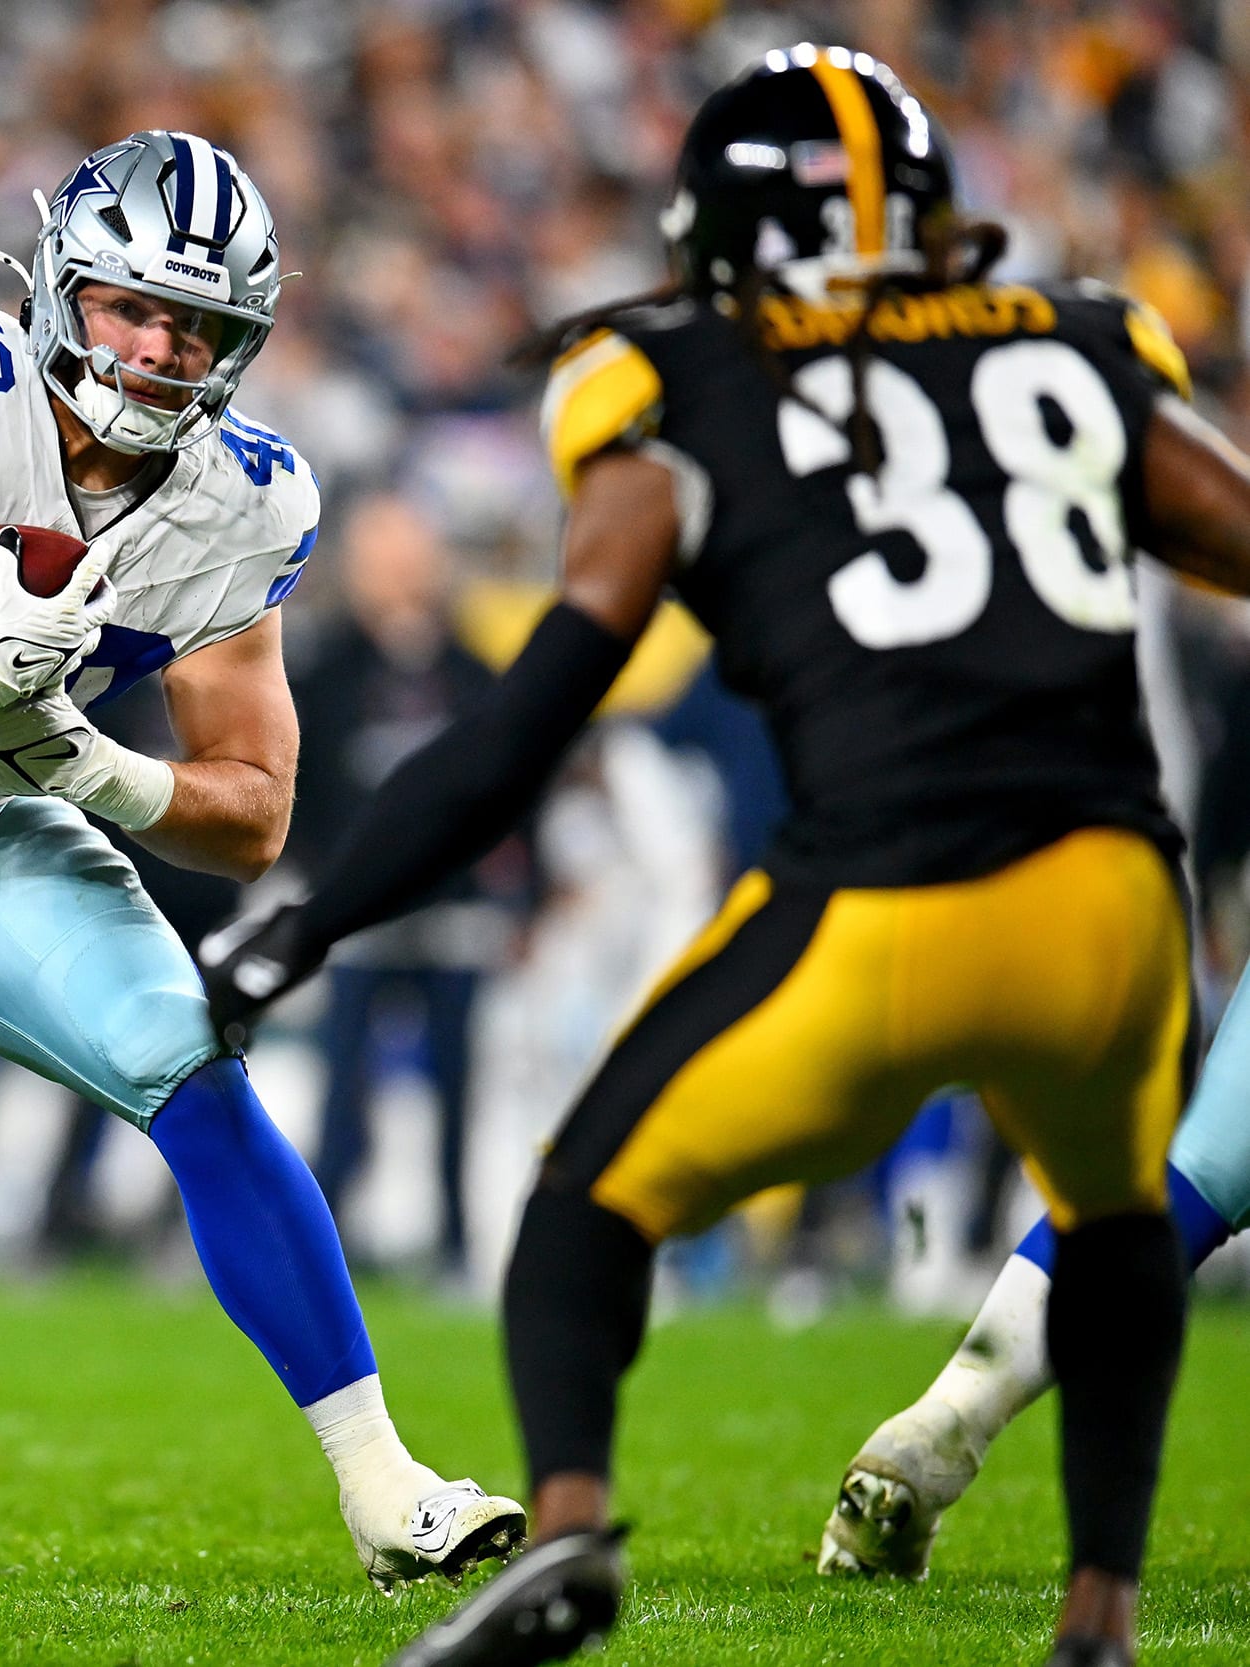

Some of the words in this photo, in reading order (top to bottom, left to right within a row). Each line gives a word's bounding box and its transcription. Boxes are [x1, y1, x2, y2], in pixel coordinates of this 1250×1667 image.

[165, 259, 221, 284] COWBOYS
[219, 407, 295, 487] 4
[776, 339, 1142, 650] 38
